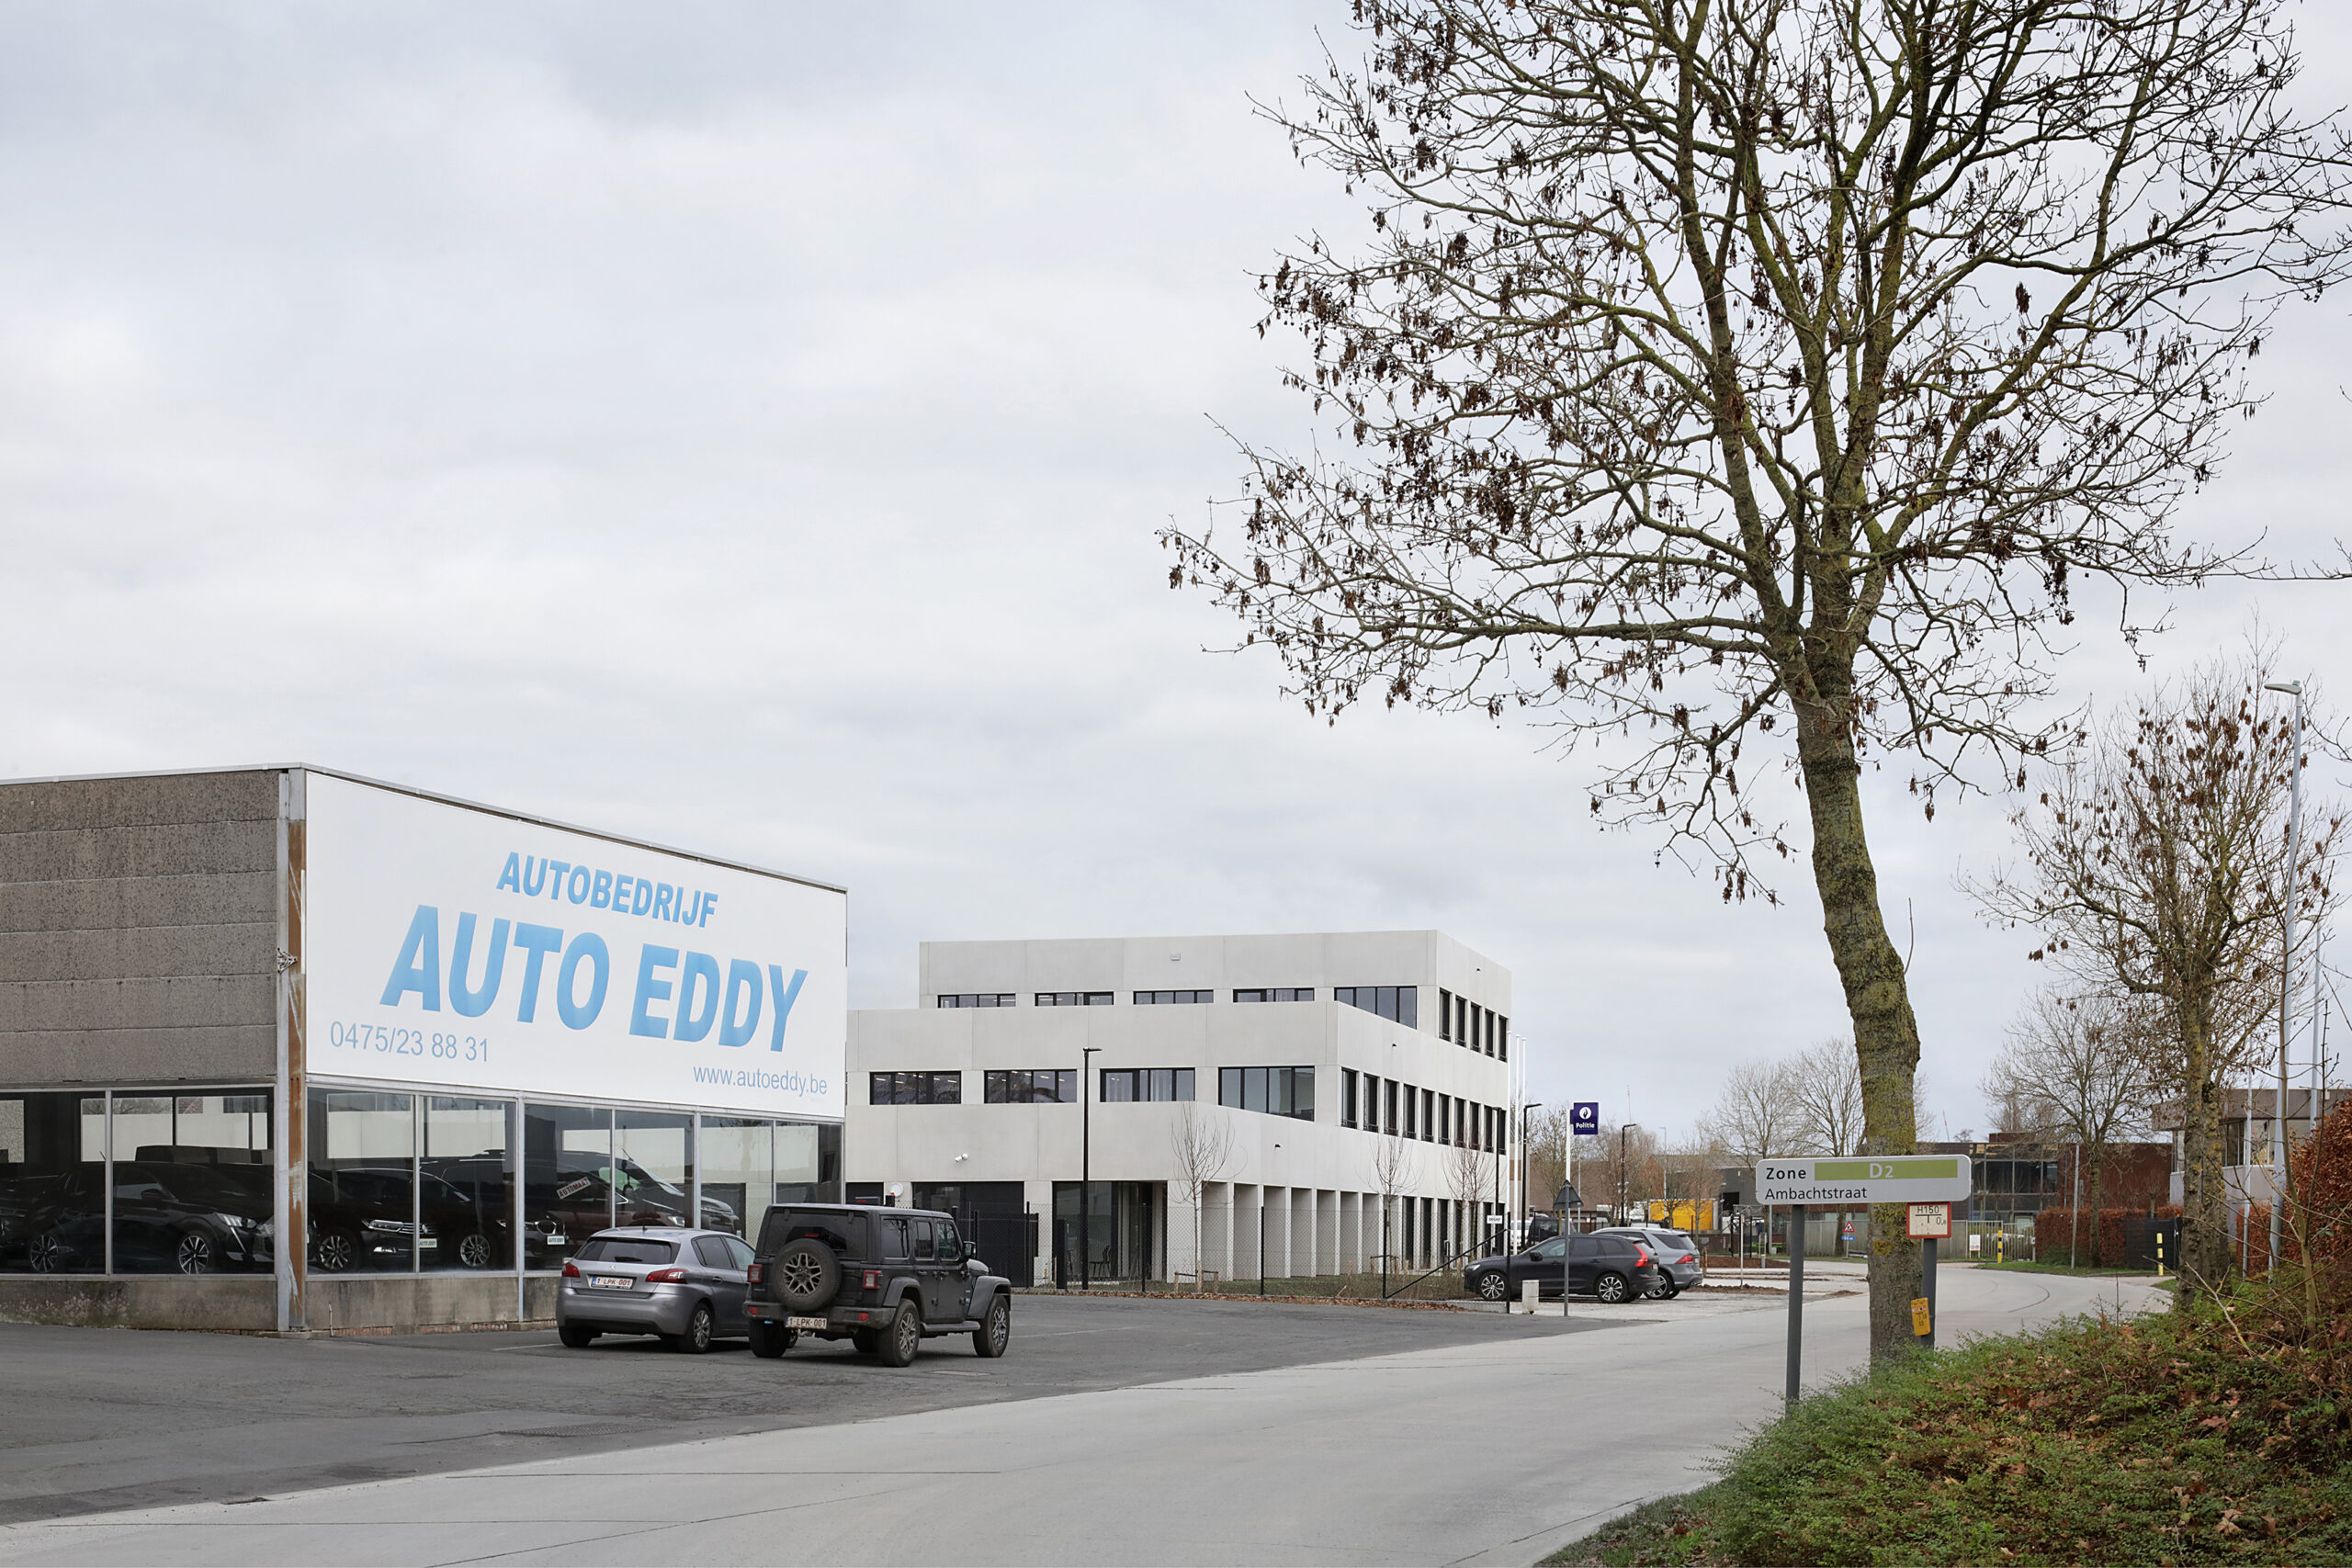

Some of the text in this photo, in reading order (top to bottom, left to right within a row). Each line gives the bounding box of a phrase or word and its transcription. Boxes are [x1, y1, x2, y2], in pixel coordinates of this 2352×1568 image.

[496, 851, 718, 929] AUTOBEDRIJF
[379, 904, 808, 1053] AUTO EDDY
[330, 1021, 489, 1063] 0475/23 88 31
[693, 1066, 828, 1098] www.autoeddy.be
[1766, 1162, 1894, 1180] Zone D2
[1765, 1186, 1868, 1201] Ambachtstraat
[1917, 1205, 1939, 1214] H150
